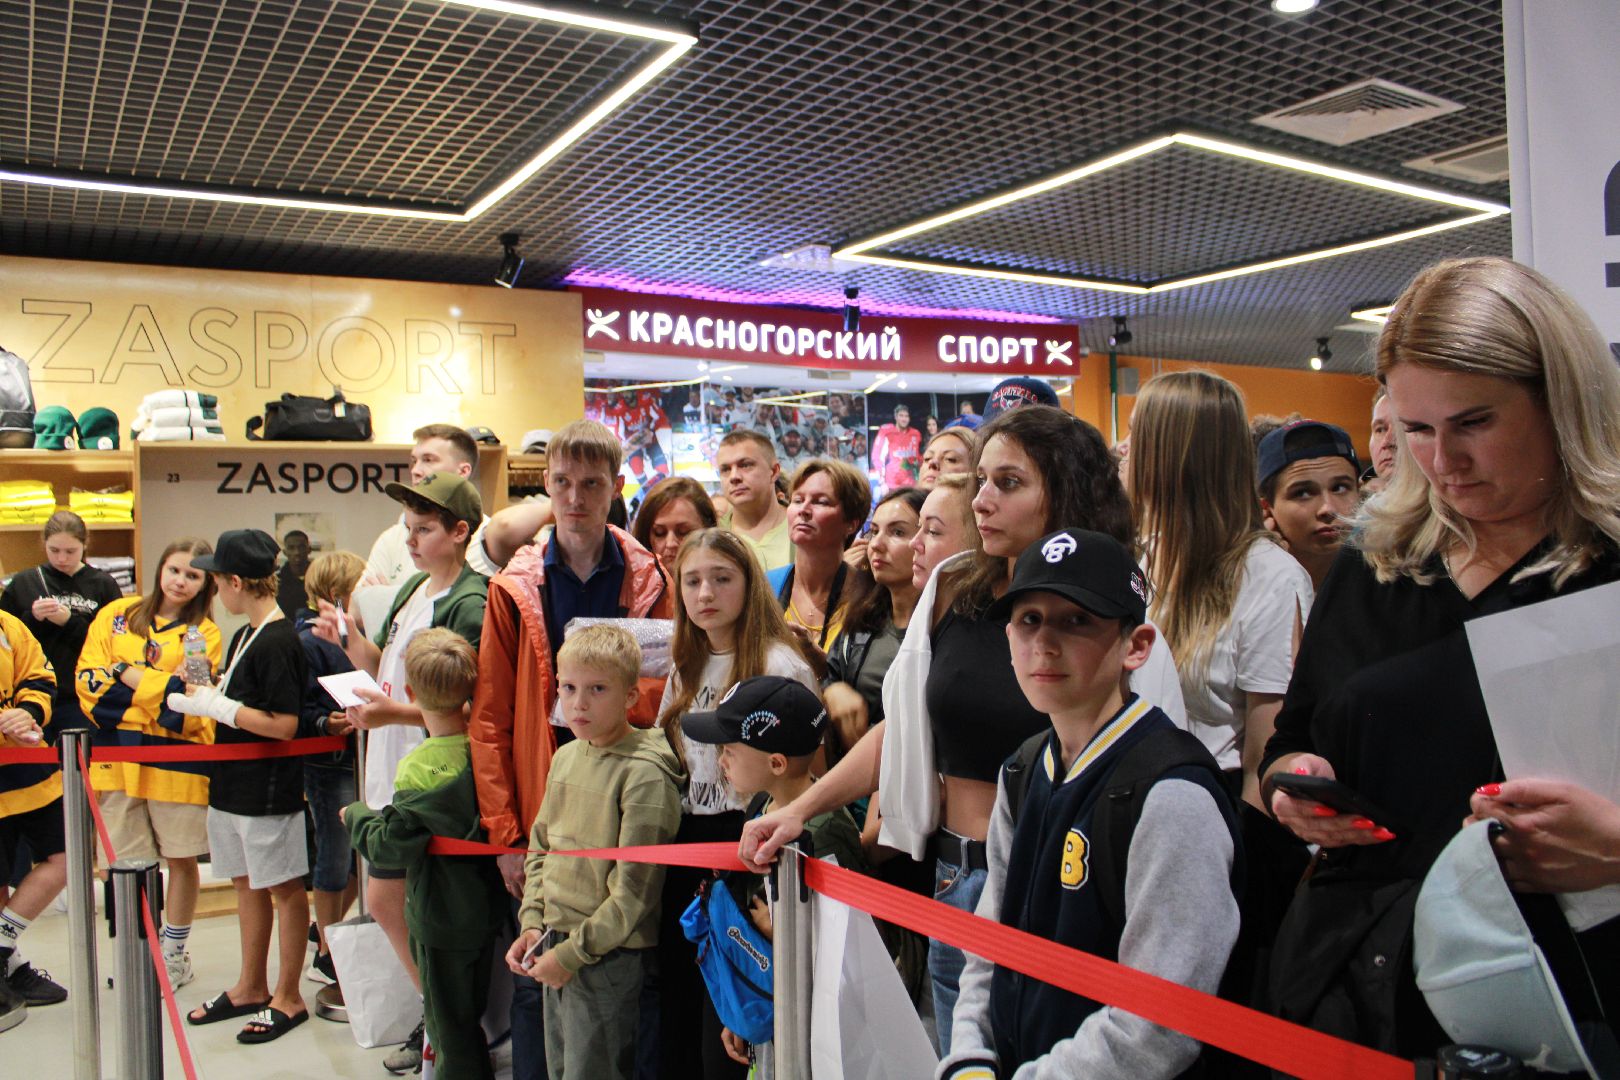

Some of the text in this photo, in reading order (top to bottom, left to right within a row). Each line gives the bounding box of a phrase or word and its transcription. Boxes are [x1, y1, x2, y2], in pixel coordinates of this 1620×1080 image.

[22, 298, 516, 395] ZASPORT
[629, 310, 1038, 365] КРАСНОГОРСКИЙ СПОРТ
[167, 473, 180, 483] 23
[217, 462, 409, 494] ZASPORT
[1060, 827, 1090, 890] B
